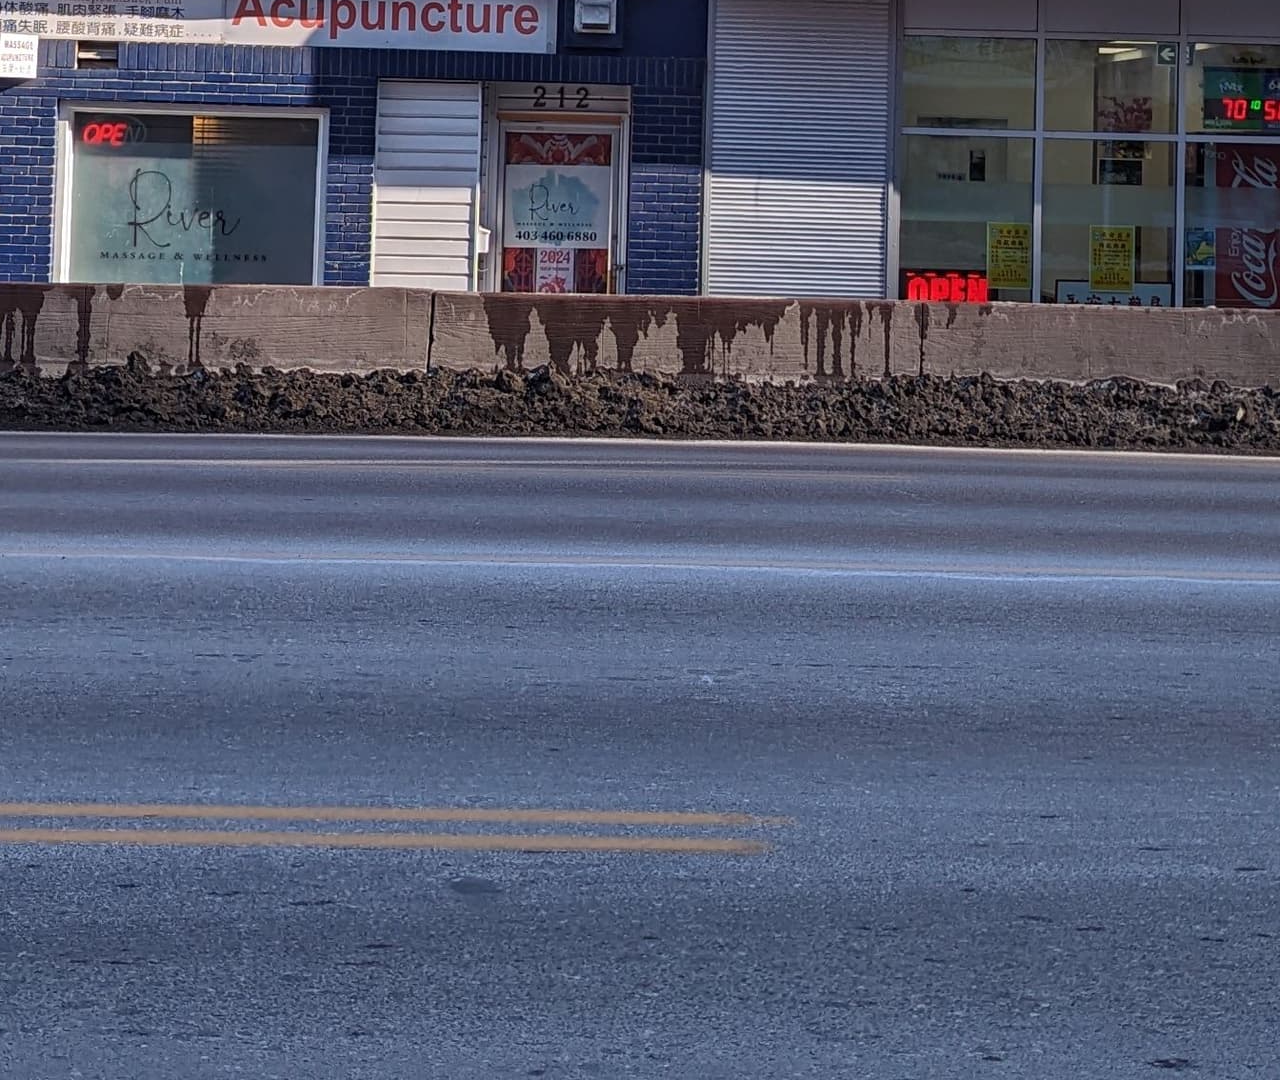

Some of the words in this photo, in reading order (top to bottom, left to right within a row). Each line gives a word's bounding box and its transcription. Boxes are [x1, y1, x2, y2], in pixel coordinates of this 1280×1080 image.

[533, 85, 590, 108] 212
[1250, 100, 1261, 110] 10
[1222, 99, 1247, 120] 70
[83, 122, 145, 146] OPEN
[127, 168, 240, 247] River
[528, 183, 580, 221] River
[99, 251, 166, 260] MASSAGE
[174, 252, 184, 260] &
[193, 252, 268, 262] WELLNESS
[540, 250, 571, 264] 2024
[908, 276, 988, 303] OPEN
